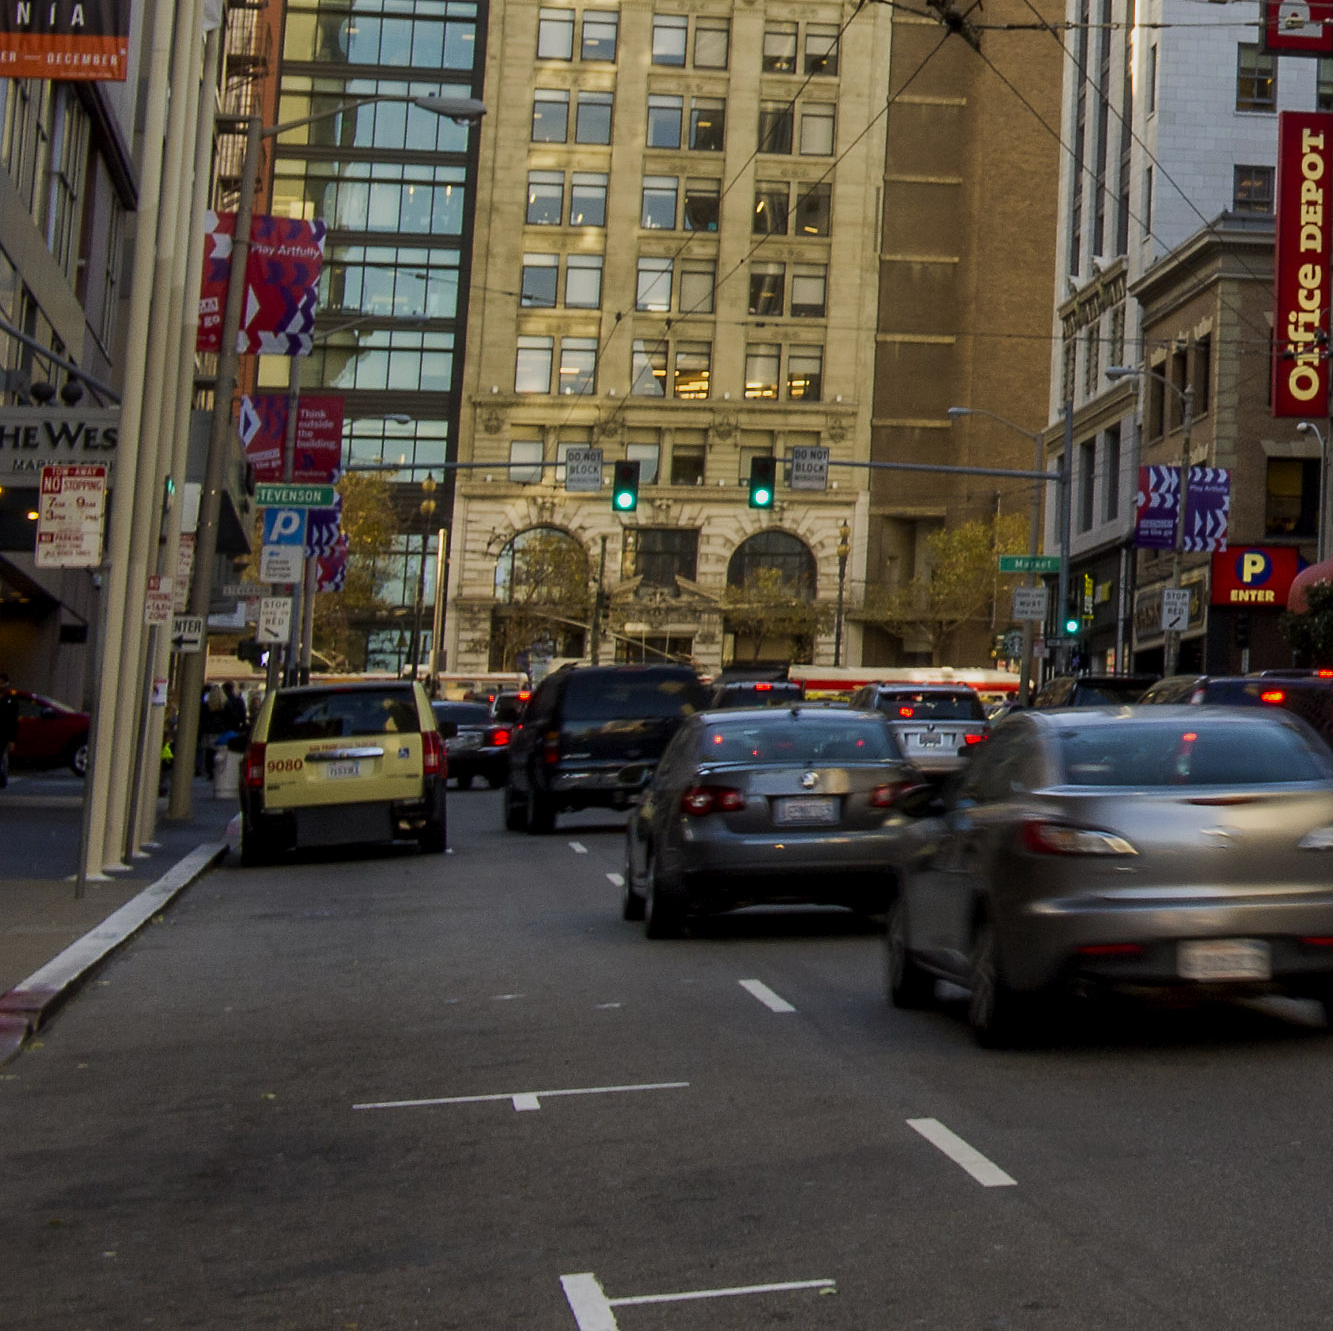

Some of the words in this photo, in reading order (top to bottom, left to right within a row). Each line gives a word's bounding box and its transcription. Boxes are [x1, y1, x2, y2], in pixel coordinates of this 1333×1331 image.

[46, 52, 118, 67] DECEMBER
[1299, 127, 1325, 253] DEPOT
[251, 242, 274, 256] Play
[278, 244, 320, 259] Artfully
[1287, 263, 1322, 402] Office
[300, 409, 327, 418] Think
[298, 419, 334, 429] outside
[298, 429, 315, 438] the
[568, 452, 581, 461] DO
[583, 451, 601, 462] NOT
[793, 449, 809, 460] DO
[810, 450, 828, 461] NOT
[569, 464, 599, 475] BLOCK
[793, 462, 824, 474] BLOCK
[43, 476, 61, 492] NO
[63, 479, 102, 492] STOPPING
[1014, 559, 1052, 569] Market
[1242, 553, 1266, 583] P
[1166, 592, 1188, 600] STOP
[1229, 589, 1276, 603] ENTER
[264, 600, 289, 609] STOP
[1167, 607, 1185, 615] RED
[264, 618, 285, 626] RED
[267, 758, 303, 774] 9080
